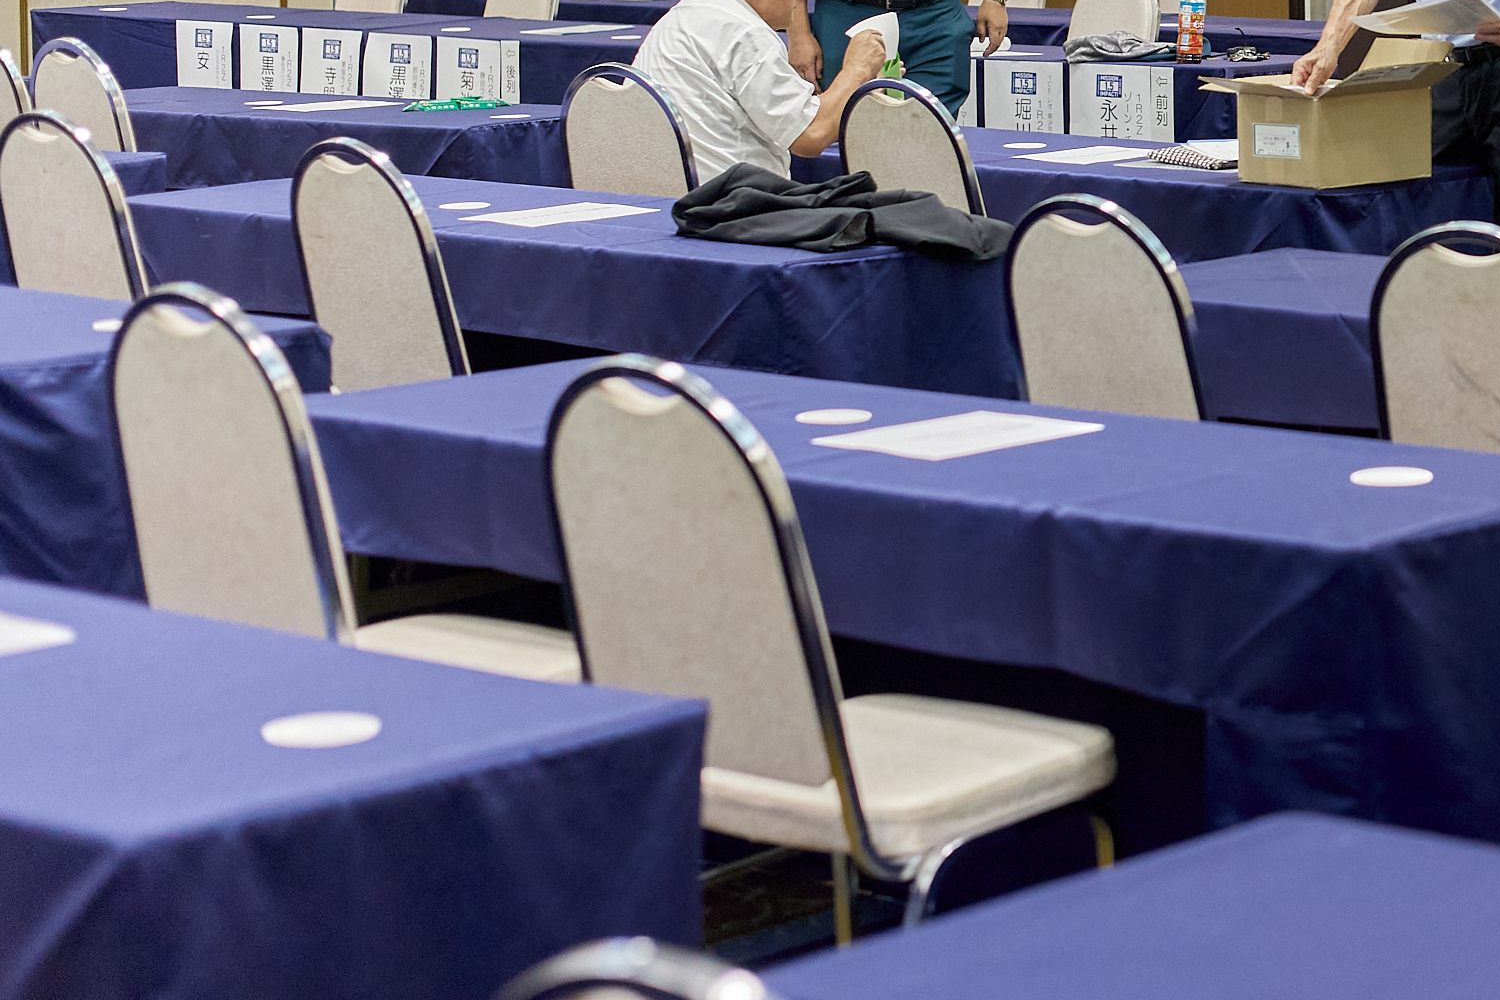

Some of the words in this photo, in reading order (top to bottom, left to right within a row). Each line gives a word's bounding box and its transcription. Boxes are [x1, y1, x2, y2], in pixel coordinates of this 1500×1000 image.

[197, 51, 209, 70] 安
[461, 70, 474, 97] 菊
[506, 64, 516, 94] 後列
[1019, 79, 1029, 88] 1.5
[1105, 81, 1114, 91] 1.5
[1036, 99, 1044, 130] 1R2
[1135, 93, 1143, 136] 1R2Z
[1155, 94, 1168, 127] 前列
